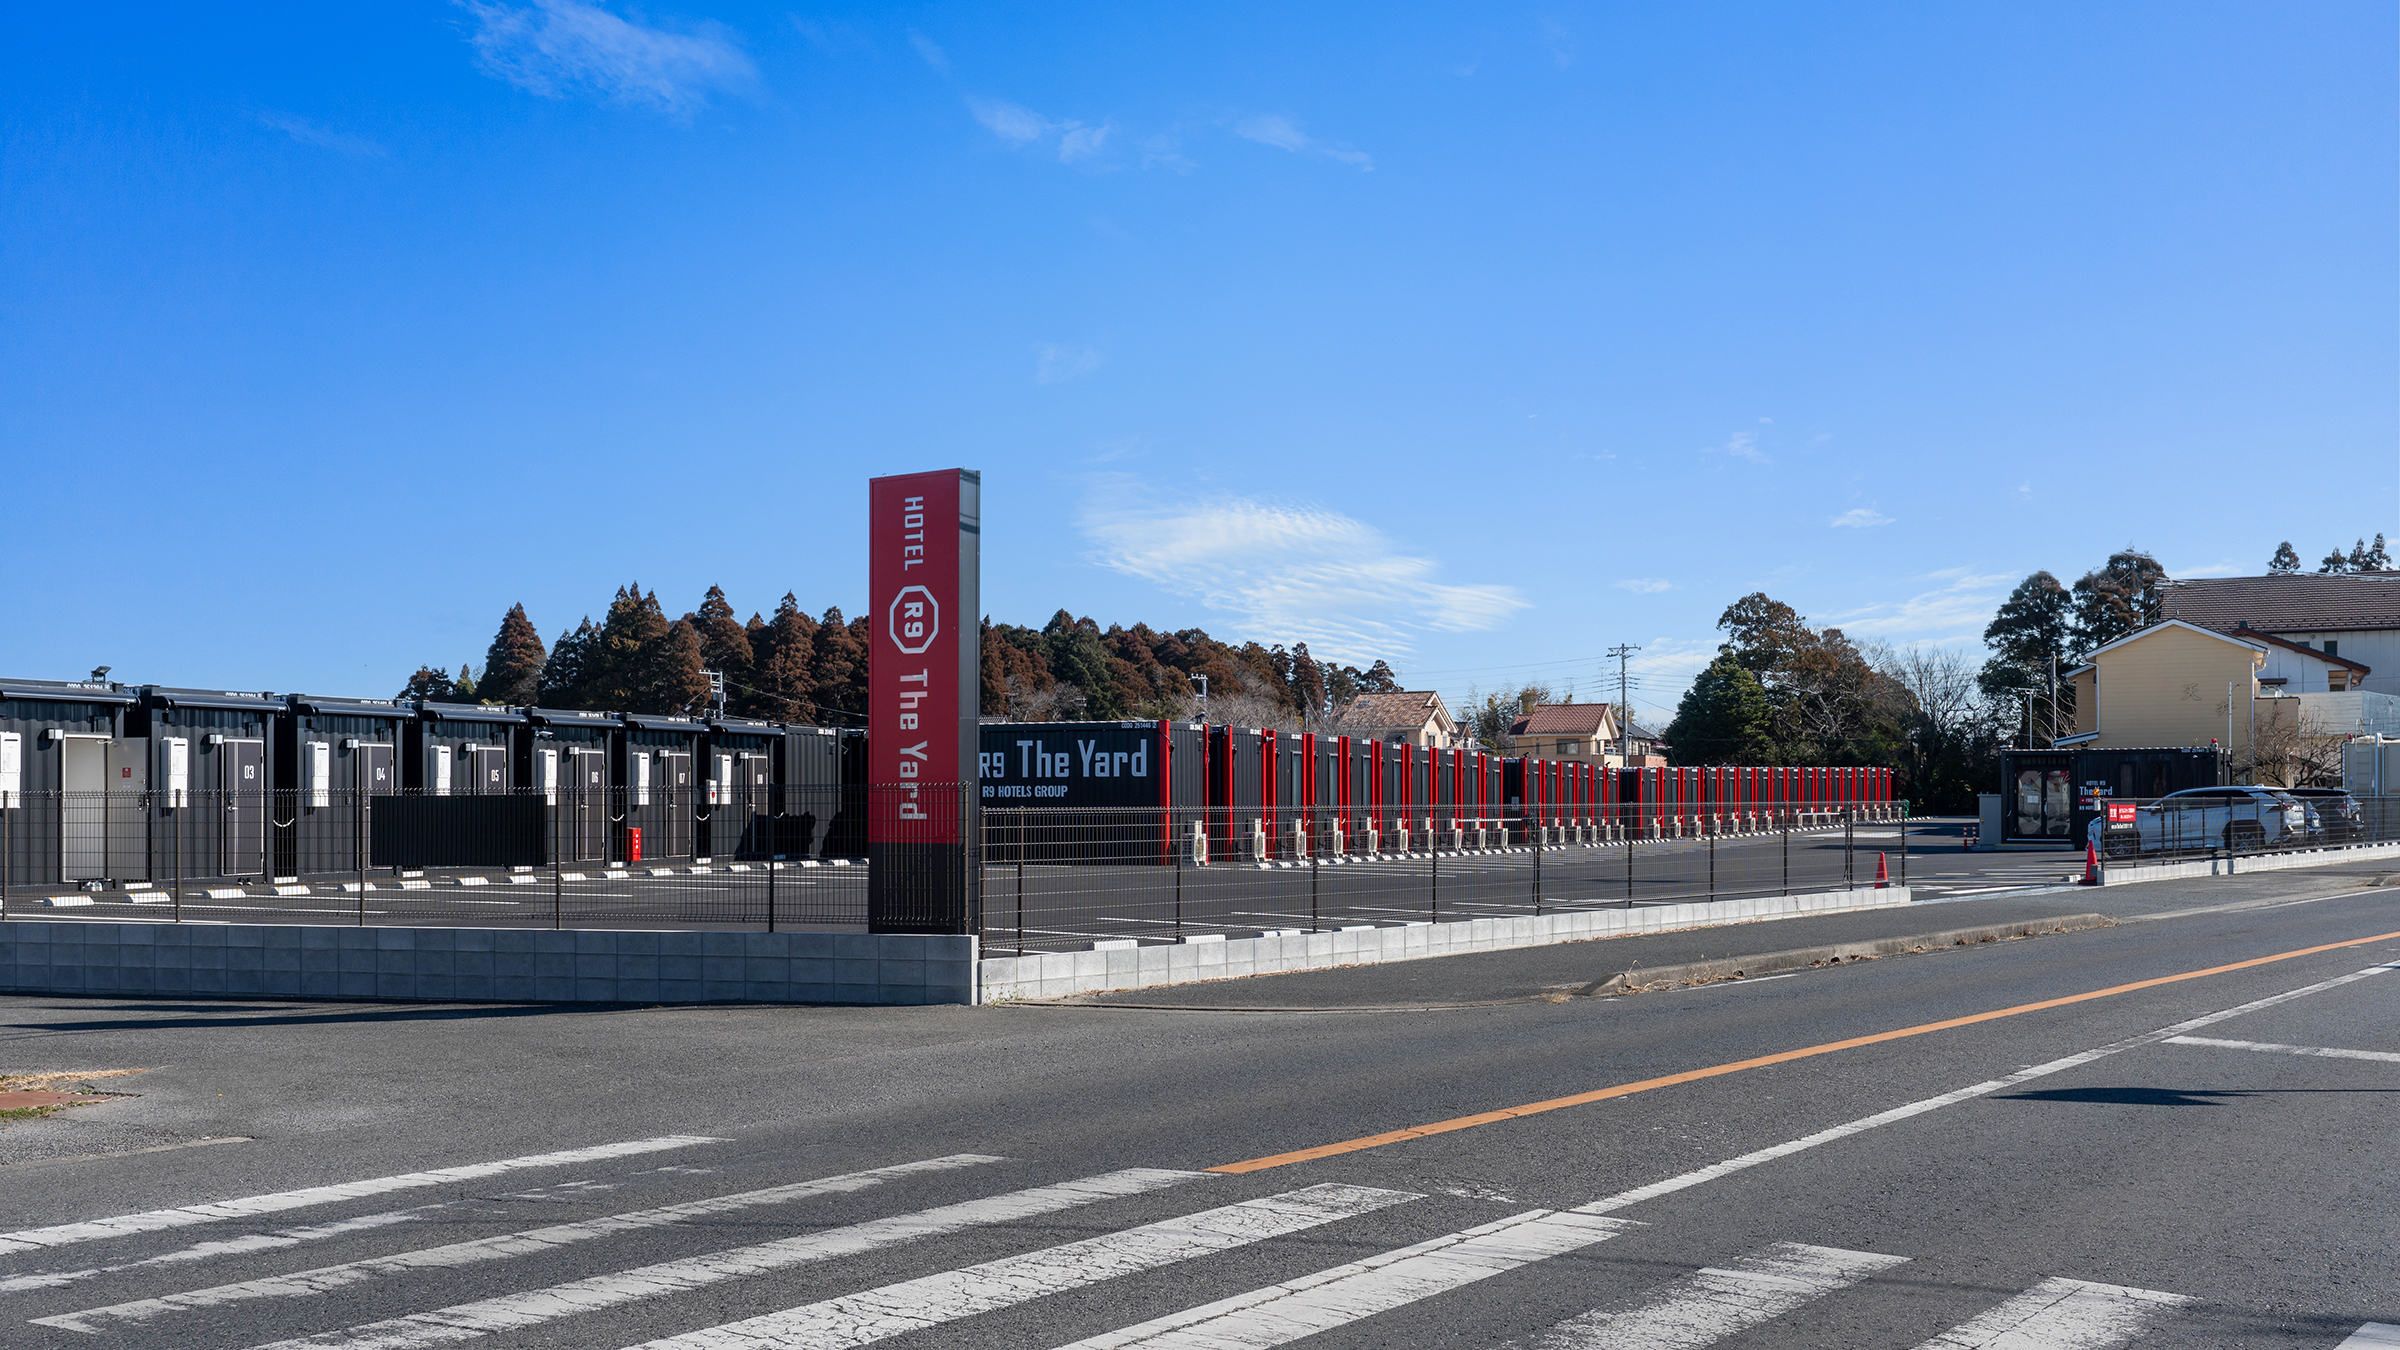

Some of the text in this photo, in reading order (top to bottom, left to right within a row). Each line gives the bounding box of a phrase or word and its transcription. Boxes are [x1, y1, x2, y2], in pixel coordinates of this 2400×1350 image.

[899, 496, 928, 820] HOTEL R9 The Yard
[979, 739, 1148, 778] R9 The Yard
[244, 764, 255, 780] 03
[376, 767, 386, 781] 04
[490, 769, 500, 782] 05
[678, 772, 686, 784] 07
[982, 786, 1068, 798] R9 HOTELS GROUP
[2079, 786, 2093, 796] The
